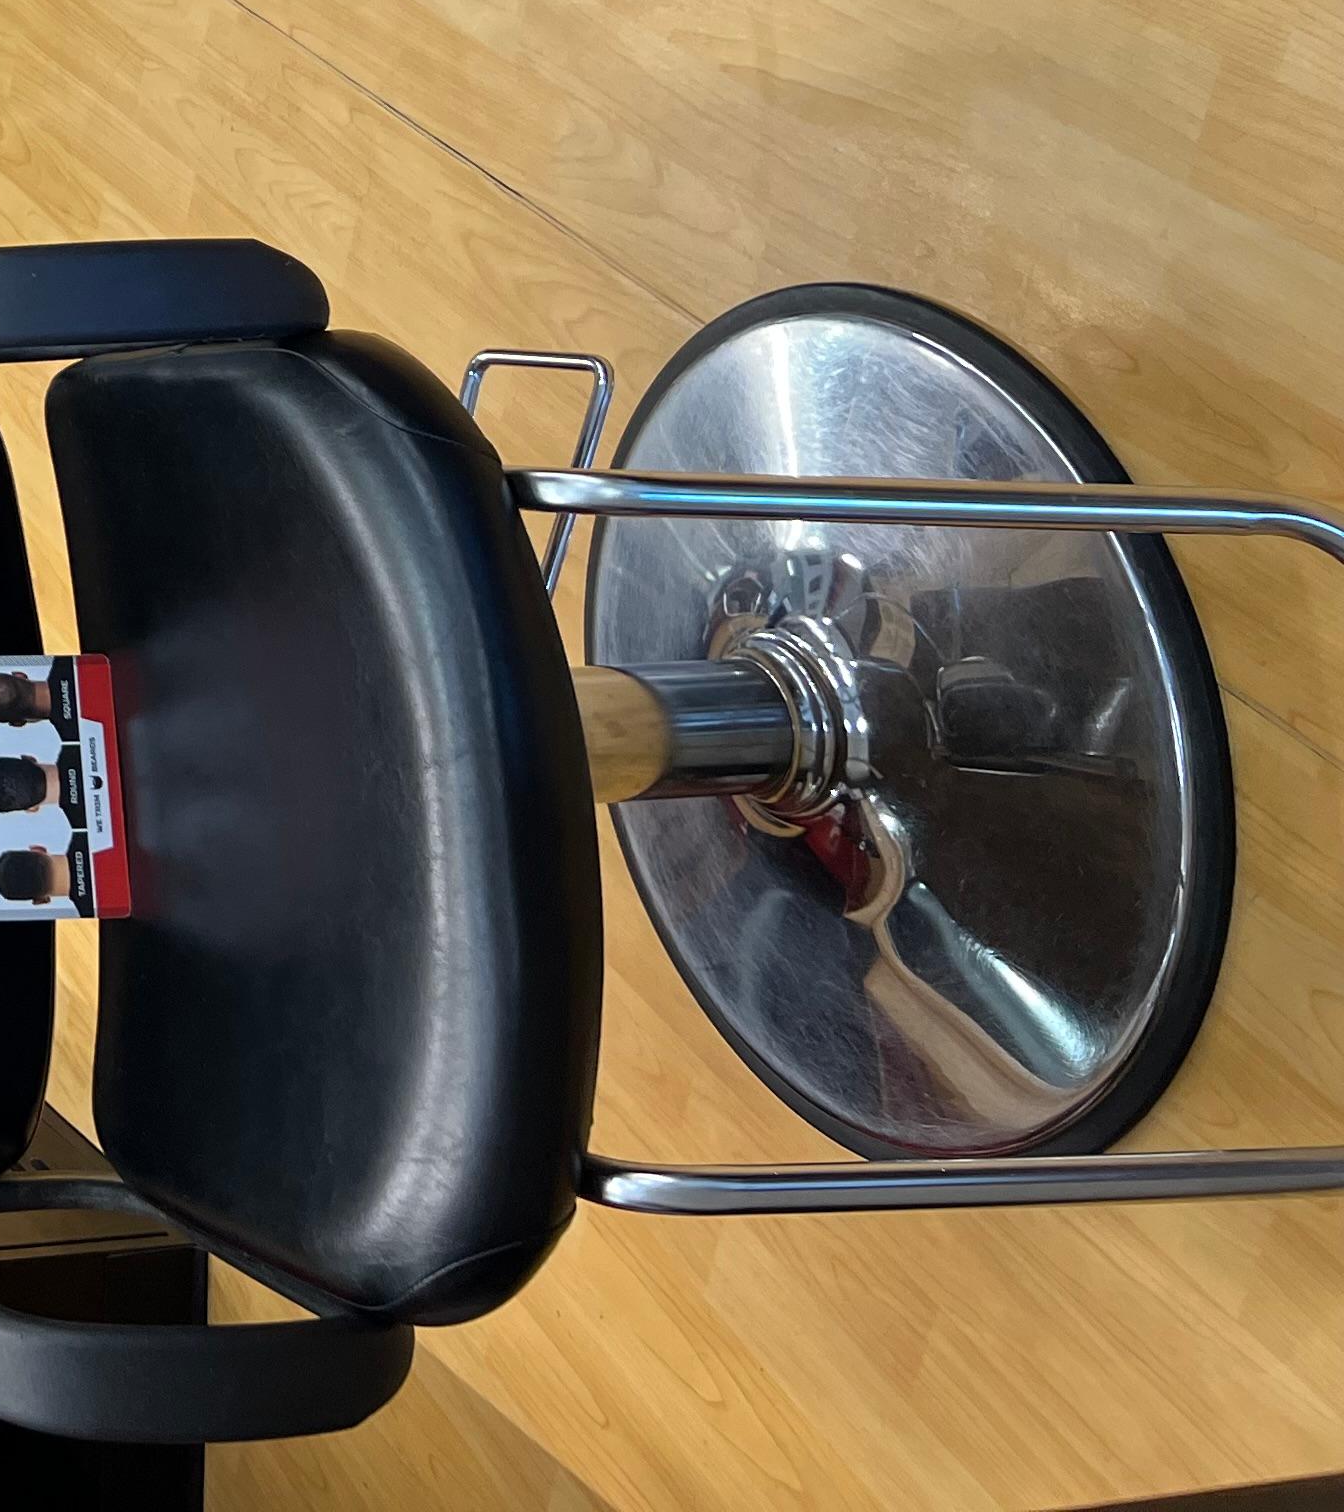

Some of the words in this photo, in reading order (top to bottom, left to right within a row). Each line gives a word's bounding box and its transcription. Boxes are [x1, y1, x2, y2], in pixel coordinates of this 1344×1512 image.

[60, 680, 72, 720] SQUARE
[88, 736, 99, 773] BEARDS
[67, 768, 79, 805] ROUND
[93, 794, 103, 817] TRIM
[95, 818, 104, 833] WE
[74, 851, 87, 897] TAPERED
